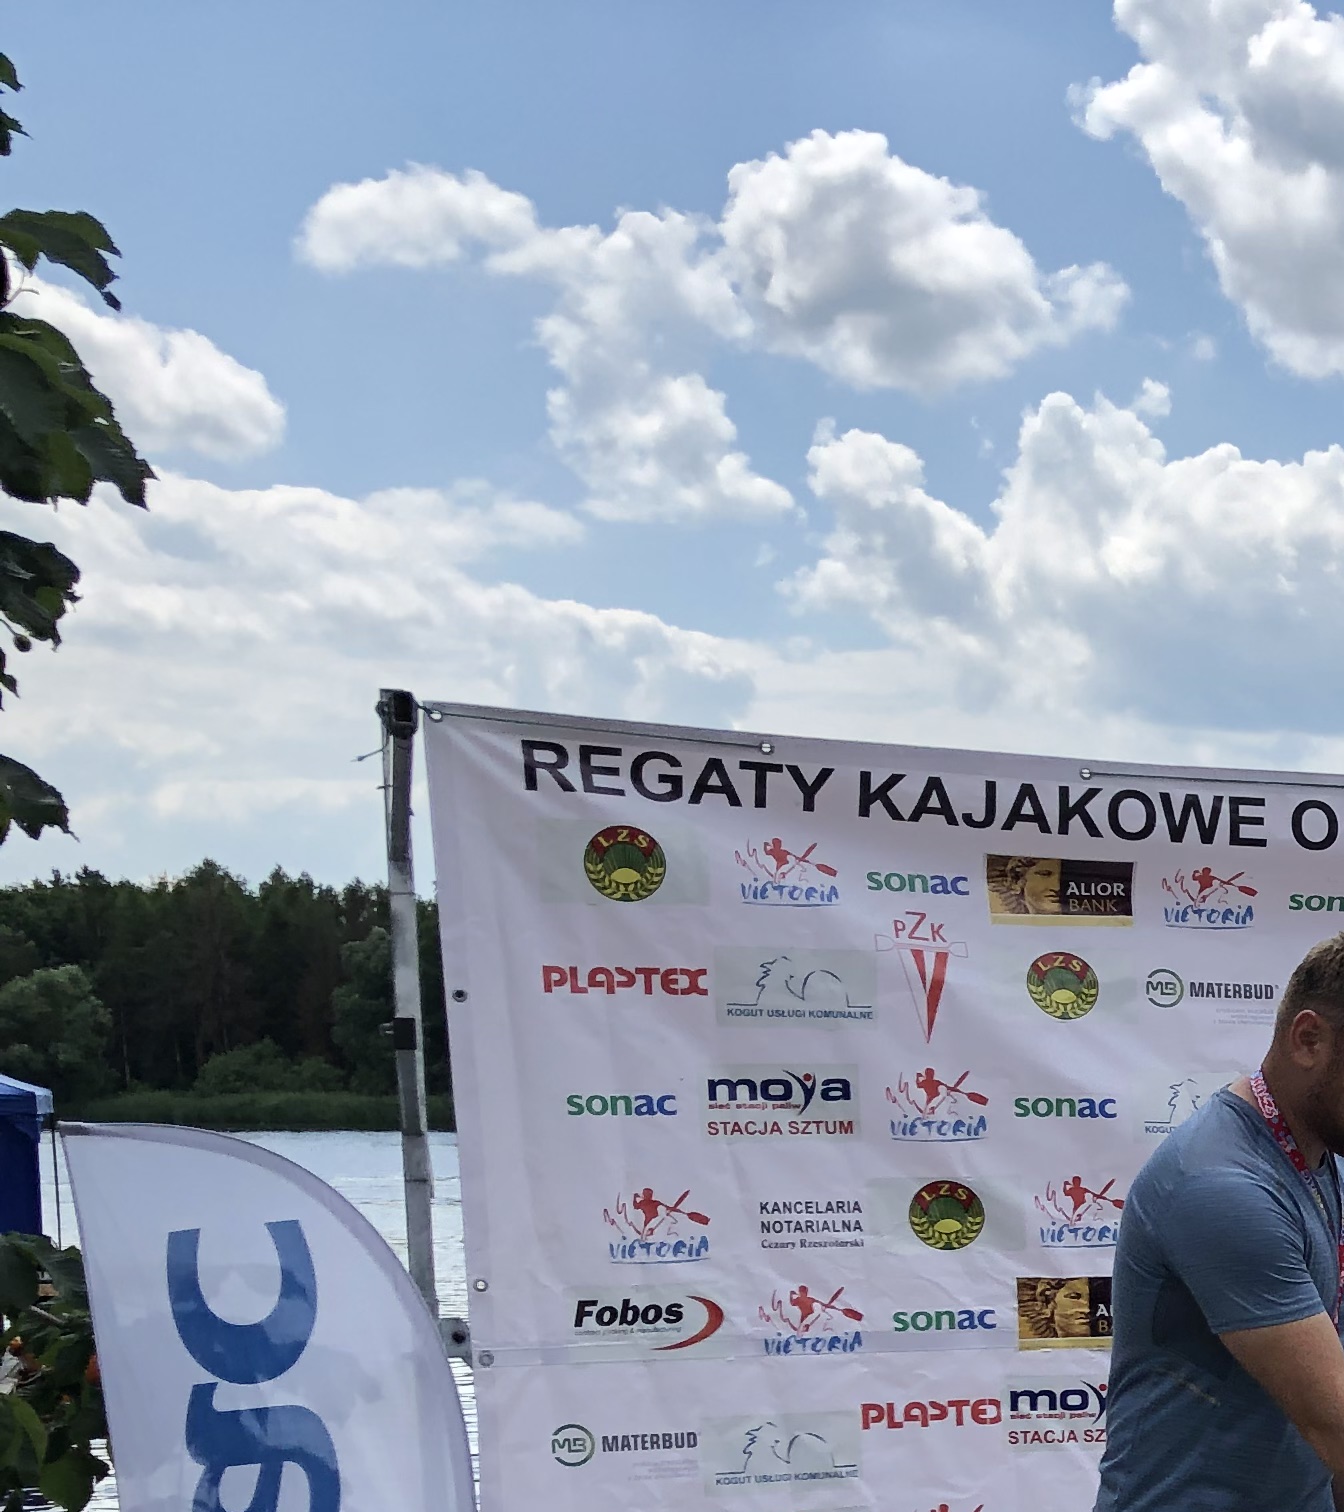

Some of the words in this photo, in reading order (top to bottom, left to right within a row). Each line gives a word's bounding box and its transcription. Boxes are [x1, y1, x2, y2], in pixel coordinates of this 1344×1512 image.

[521, 739, 835, 812] REGATY
[857, 770, 1268, 848] KAJAKOWE
[1291, 800, 1339, 851] O
[597, 829, 650, 849] LZS
[866, 871, 970, 896] sonac
[1066, 882, 1125, 898] ALIOR
[1069, 898, 1118, 913] BANK
[890, 911, 948, 944] PZK
[1036, 954, 1084, 973] LZS
[1189, 982, 1275, 1000] MATERBUD
[708, 1069, 851, 1116] moya
[566, 1093, 678, 1116] sonac
[1014, 1096, 1117, 1119] sonac
[708, 1121, 783, 1136] STACJA
[788, 1120, 853, 1135] SZTUM
[1145, 1126, 1177, 1135] KOGU
[922, 1184, 968, 1200] LZS
[760, 1201, 862, 1215] KANCELARIA
[761, 1220, 863, 1234] NOTARIALNA
[574, 1298, 684, 1328] Fobos
[893, 1309, 997, 1332] sonac
[1010, 1380, 1107, 1425] moy
[601, 1431, 698, 1453] MATERBUD
[1008, 1430, 1078, 1445] STACJA
